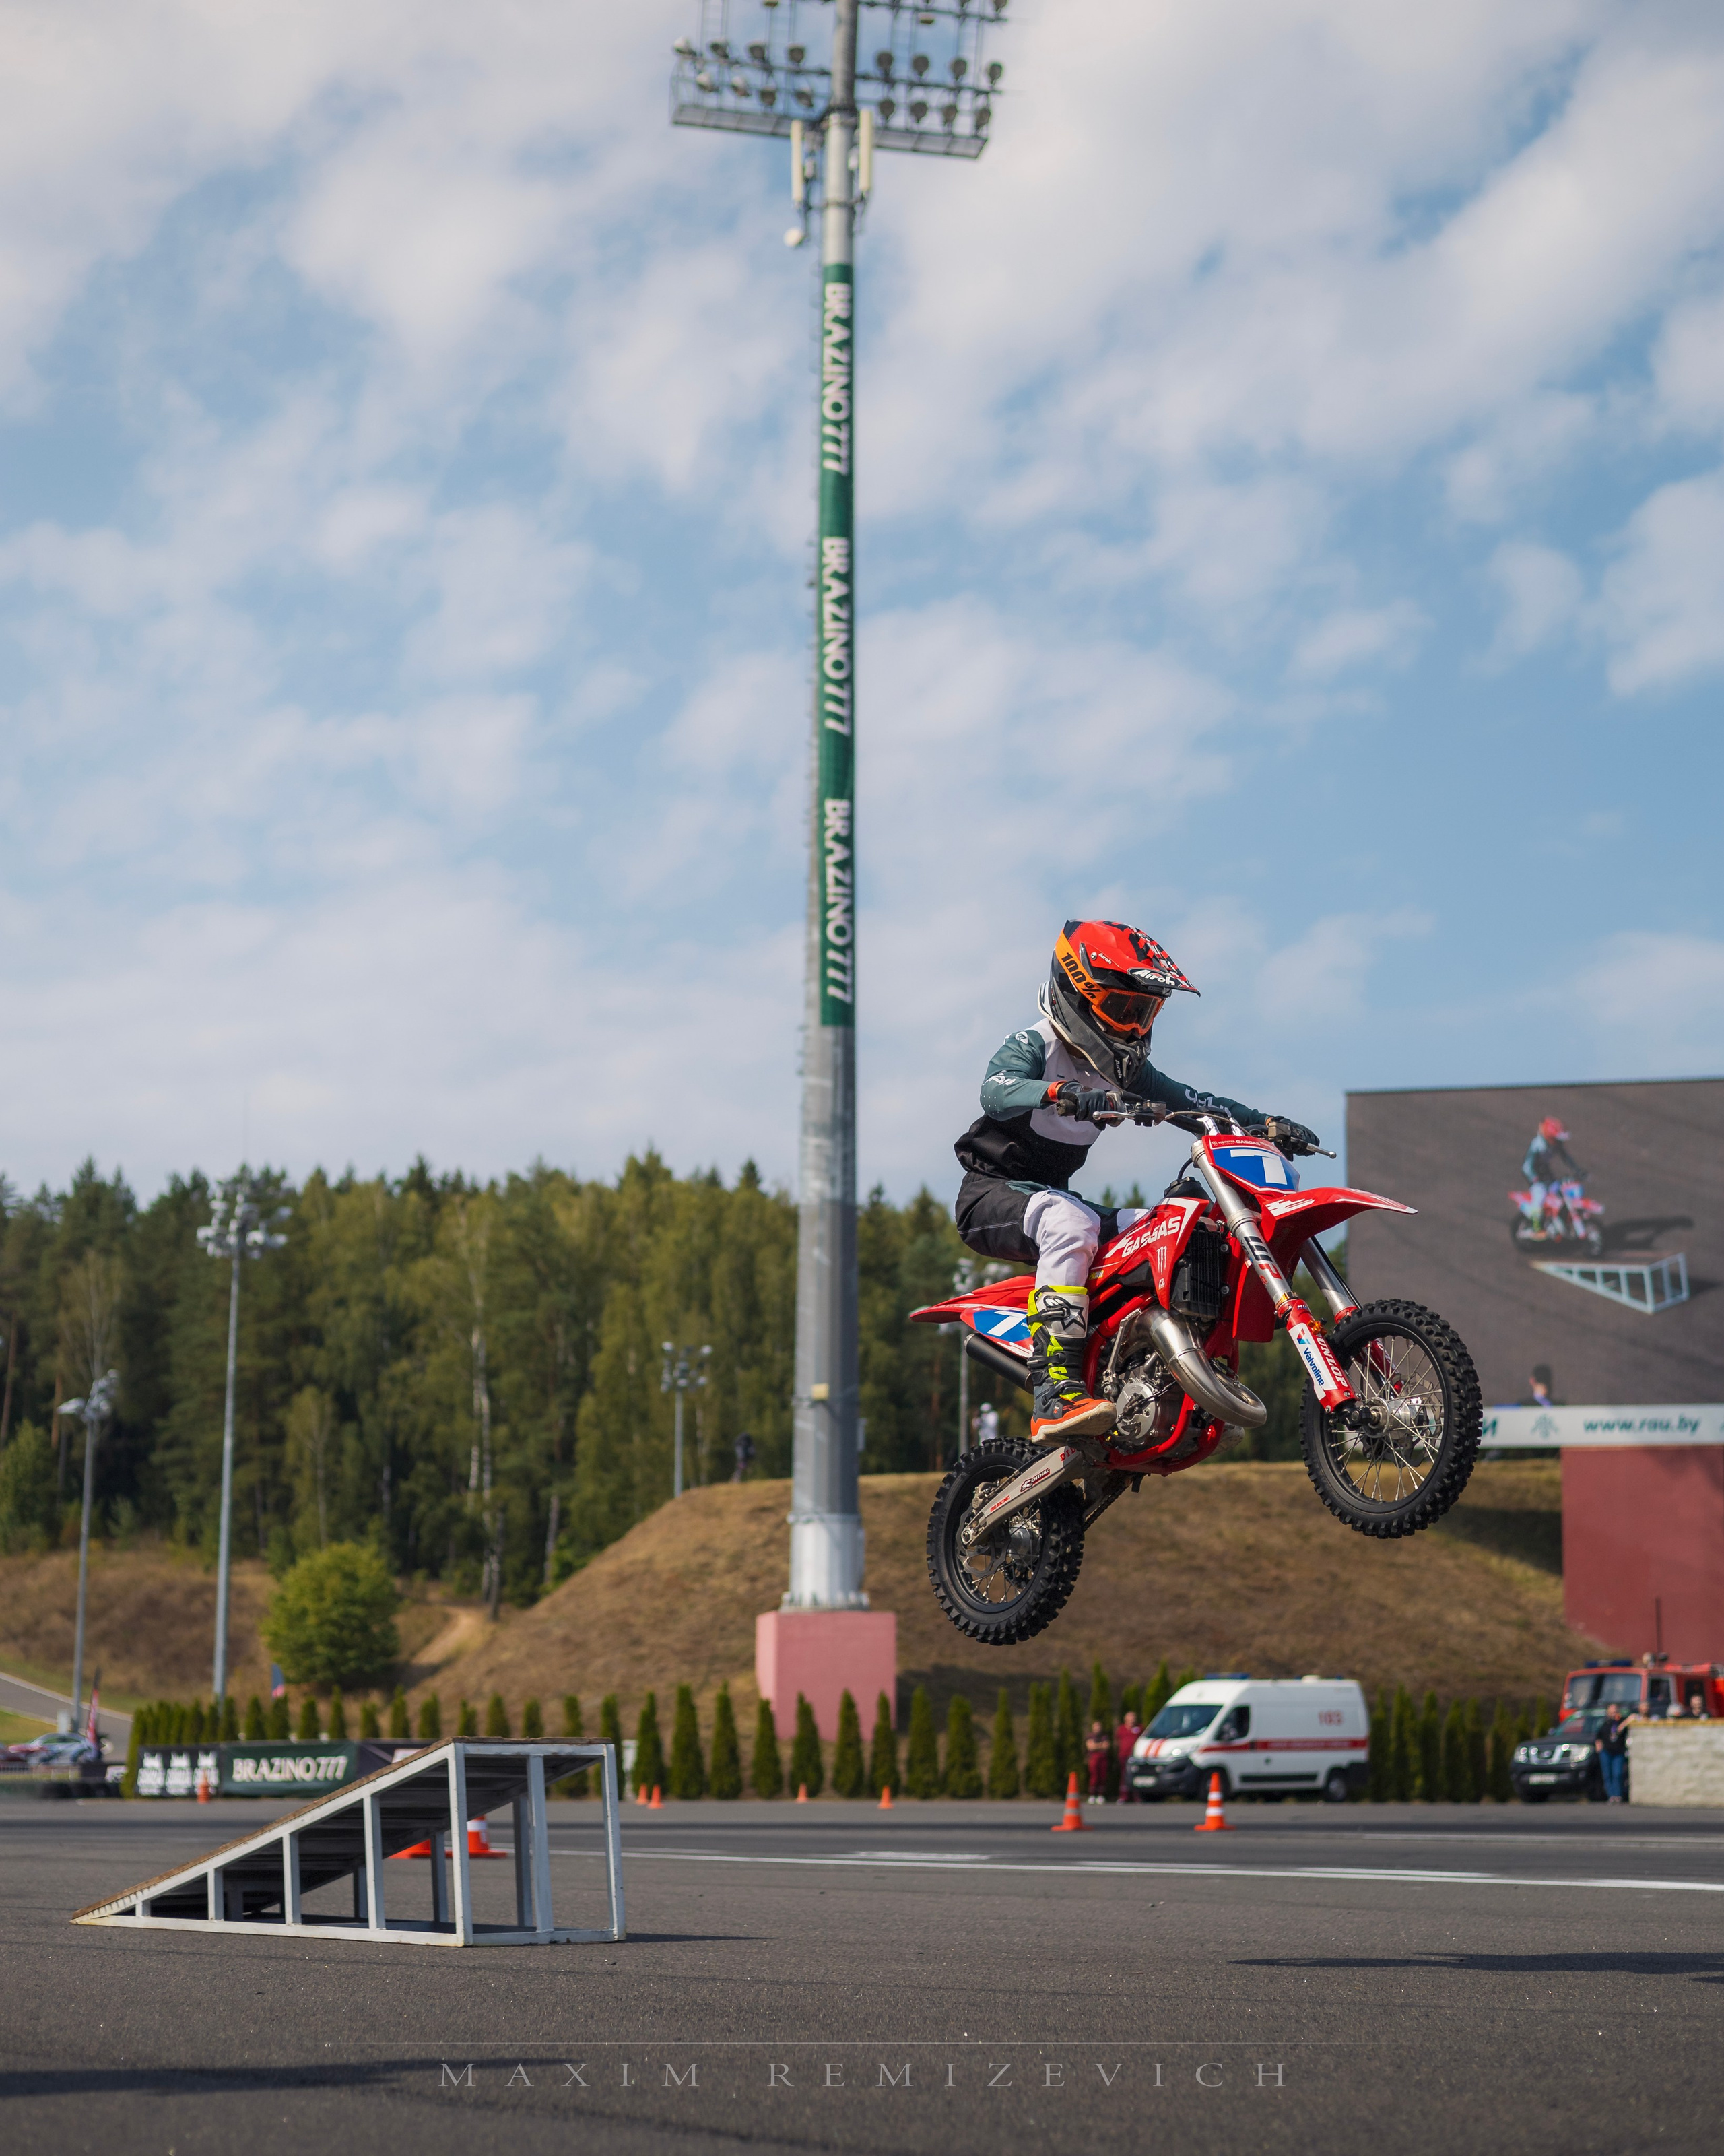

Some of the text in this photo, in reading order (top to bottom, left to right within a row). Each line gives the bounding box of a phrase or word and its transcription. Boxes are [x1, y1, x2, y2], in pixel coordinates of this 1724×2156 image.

[822, 281, 851, 476] BRAZINO777
[822, 536, 851, 736] BRAZINO777
[824, 798, 853, 1004] BRAZINO777
[1061, 952, 1102, 1000] 100%
[1098, 952, 1113, 965] Airoh
[1132, 969, 1176, 986] Airoh
[1121, 1215, 1181, 1258] GASGAS
[1304, 1346, 1325, 1387] Valvoline
[1316, 1334, 1348, 1387] UNLOP
[990, 1495, 1011, 1513] BRAKING
[232, 1755, 347, 1782] BRAZINO777
